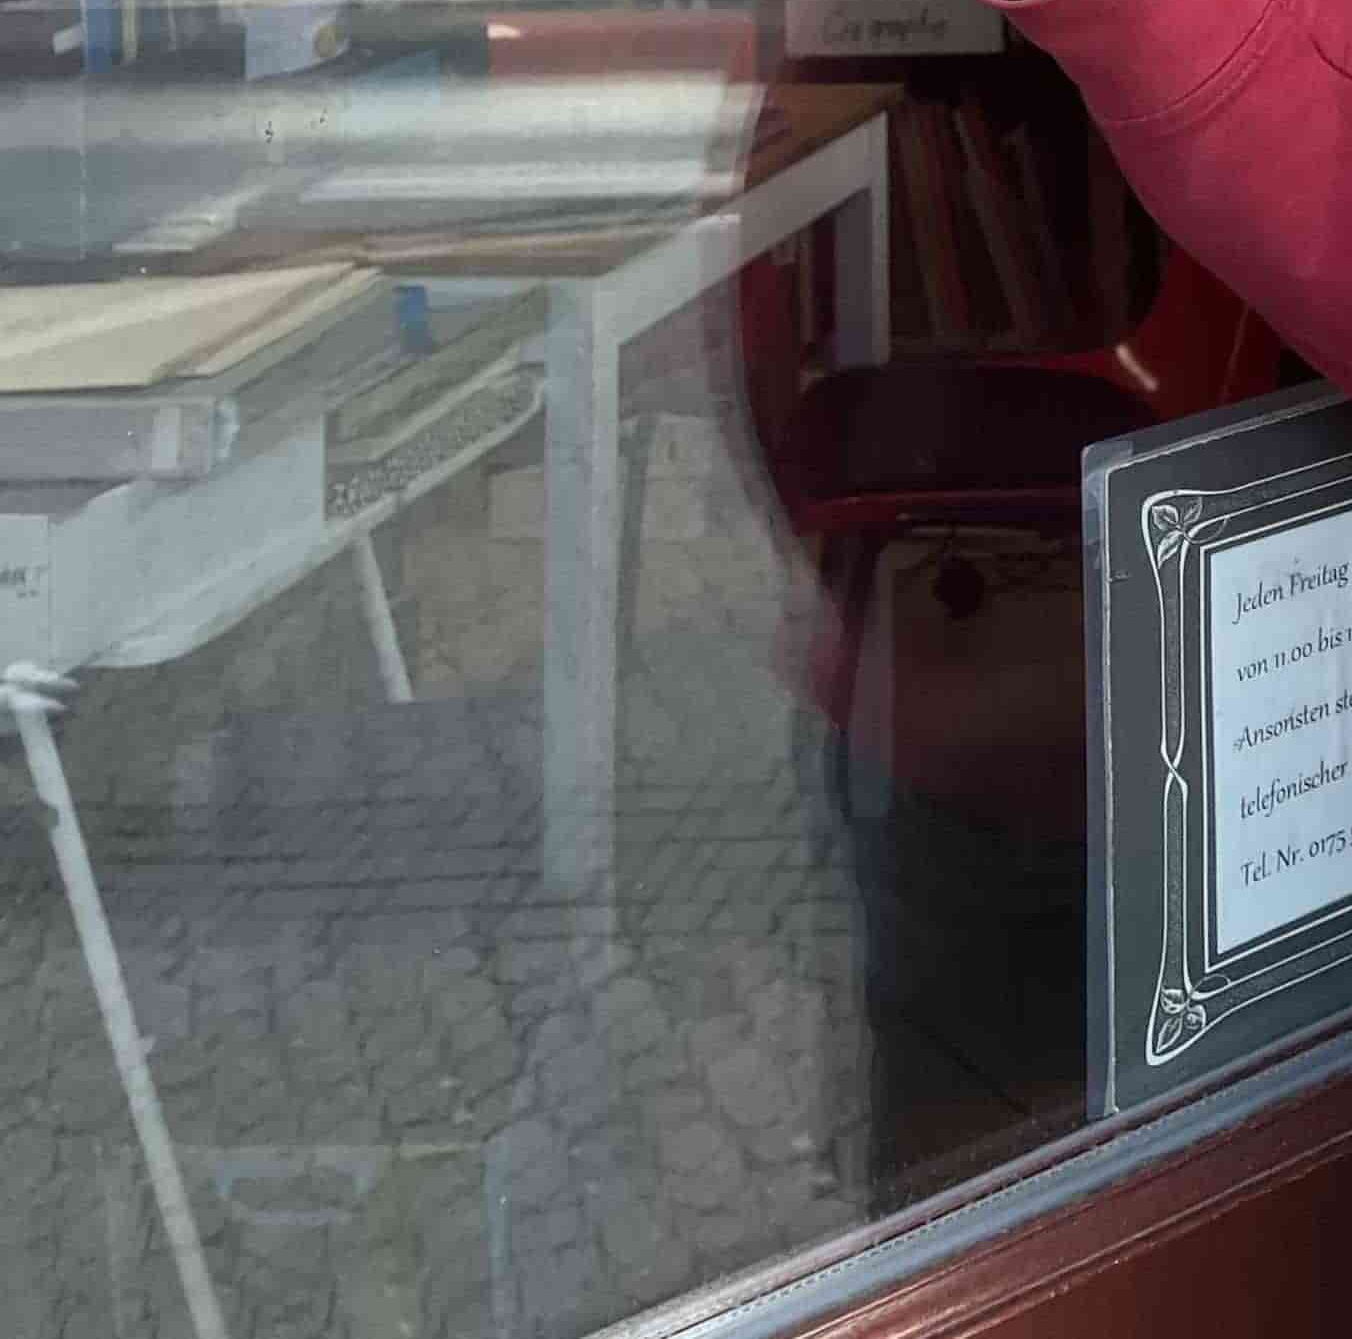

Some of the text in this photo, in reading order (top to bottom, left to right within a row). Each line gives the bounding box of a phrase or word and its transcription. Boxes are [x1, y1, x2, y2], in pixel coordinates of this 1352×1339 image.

[1232, 581, 1285, 625] Jeden
[1289, 562, 1350, 596] Freitag
[1237, 658, 1268, 681] von
[1318, 626, 1343, 653] bis
[1233, 704, 1330, 751] Ansonsten
[1240, 760, 1348, 819] telefonischer
[1240, 852, 1271, 887] Tel.
[1276, 845, 1304, 872] Nr.
[1309, 829, 1346, 858] 0175
